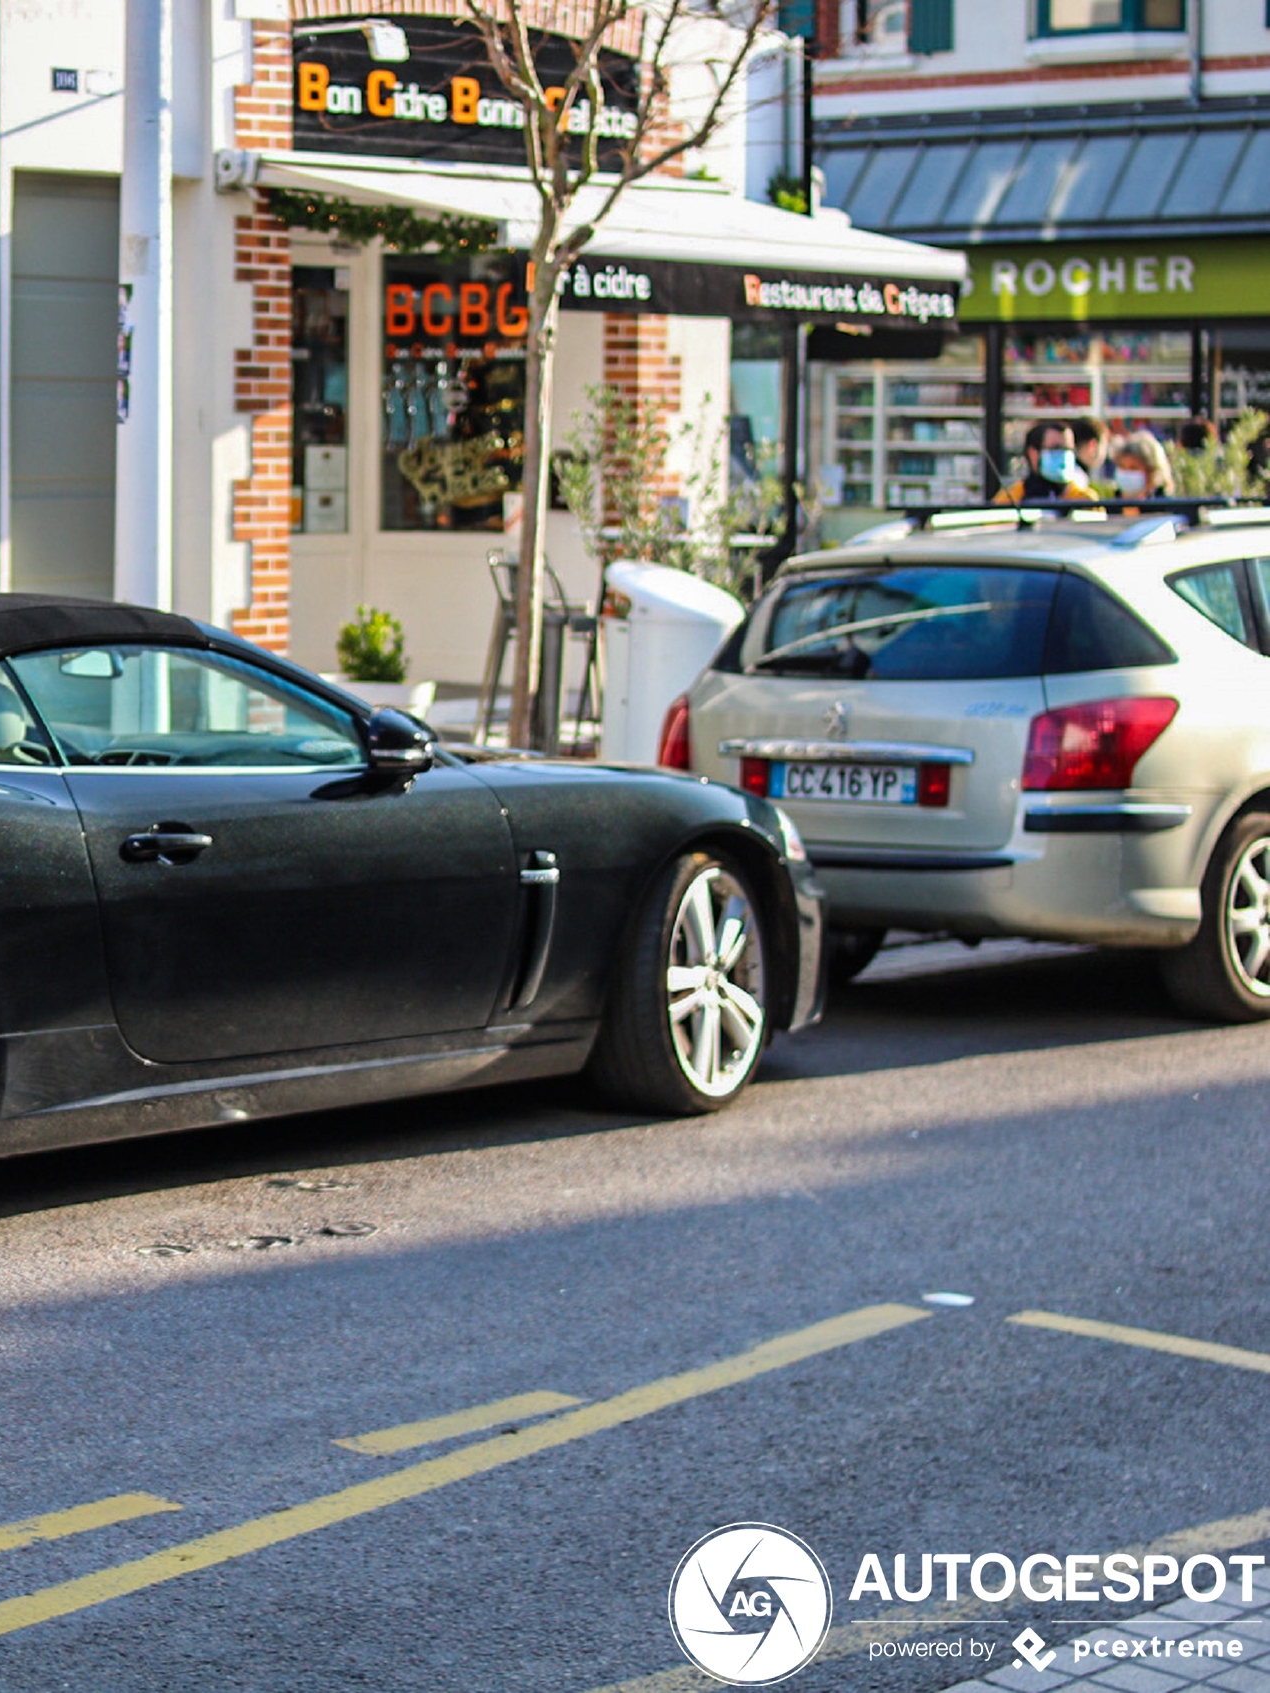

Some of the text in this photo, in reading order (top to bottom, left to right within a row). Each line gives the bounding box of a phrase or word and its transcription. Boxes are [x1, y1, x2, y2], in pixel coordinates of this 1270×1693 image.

[298, 61, 362, 114] Bon
[367, 68, 447, 122] Cidre
[451, 75, 524, 130] Bonn
[573, 264, 591, 298] à
[593, 265, 651, 300] cidre
[992, 256, 1193, 296] ROCHER
[386, 283, 530, 336] BCBG
[744, 274, 954, 324] Restaurant de Crêpes
[787, 766, 898, 798] CC-416-YP
